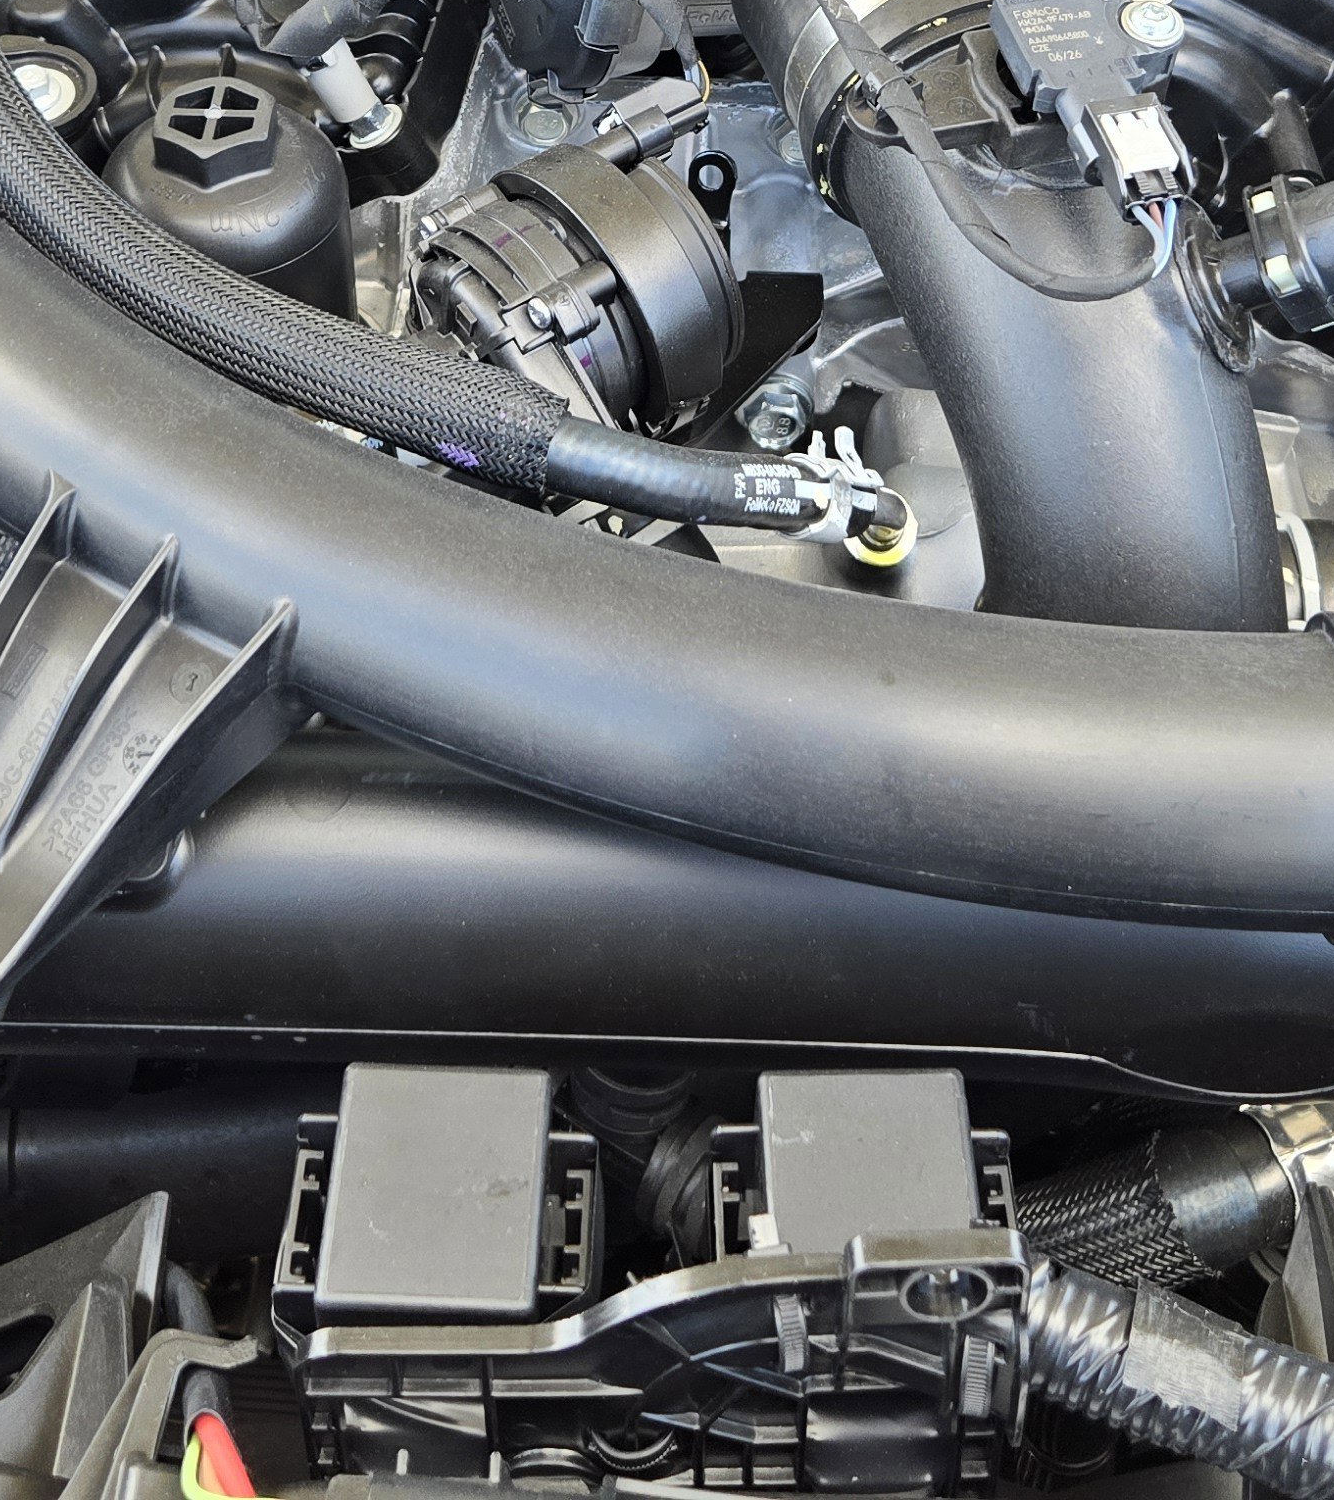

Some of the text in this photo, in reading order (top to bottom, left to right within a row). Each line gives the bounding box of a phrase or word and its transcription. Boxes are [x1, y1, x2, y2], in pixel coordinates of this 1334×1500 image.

[1012, 6, 1060, 20] FoMoCo
[1048, 50, 1083, 62] 06/26
[754, 478, 782, 497] ENG
